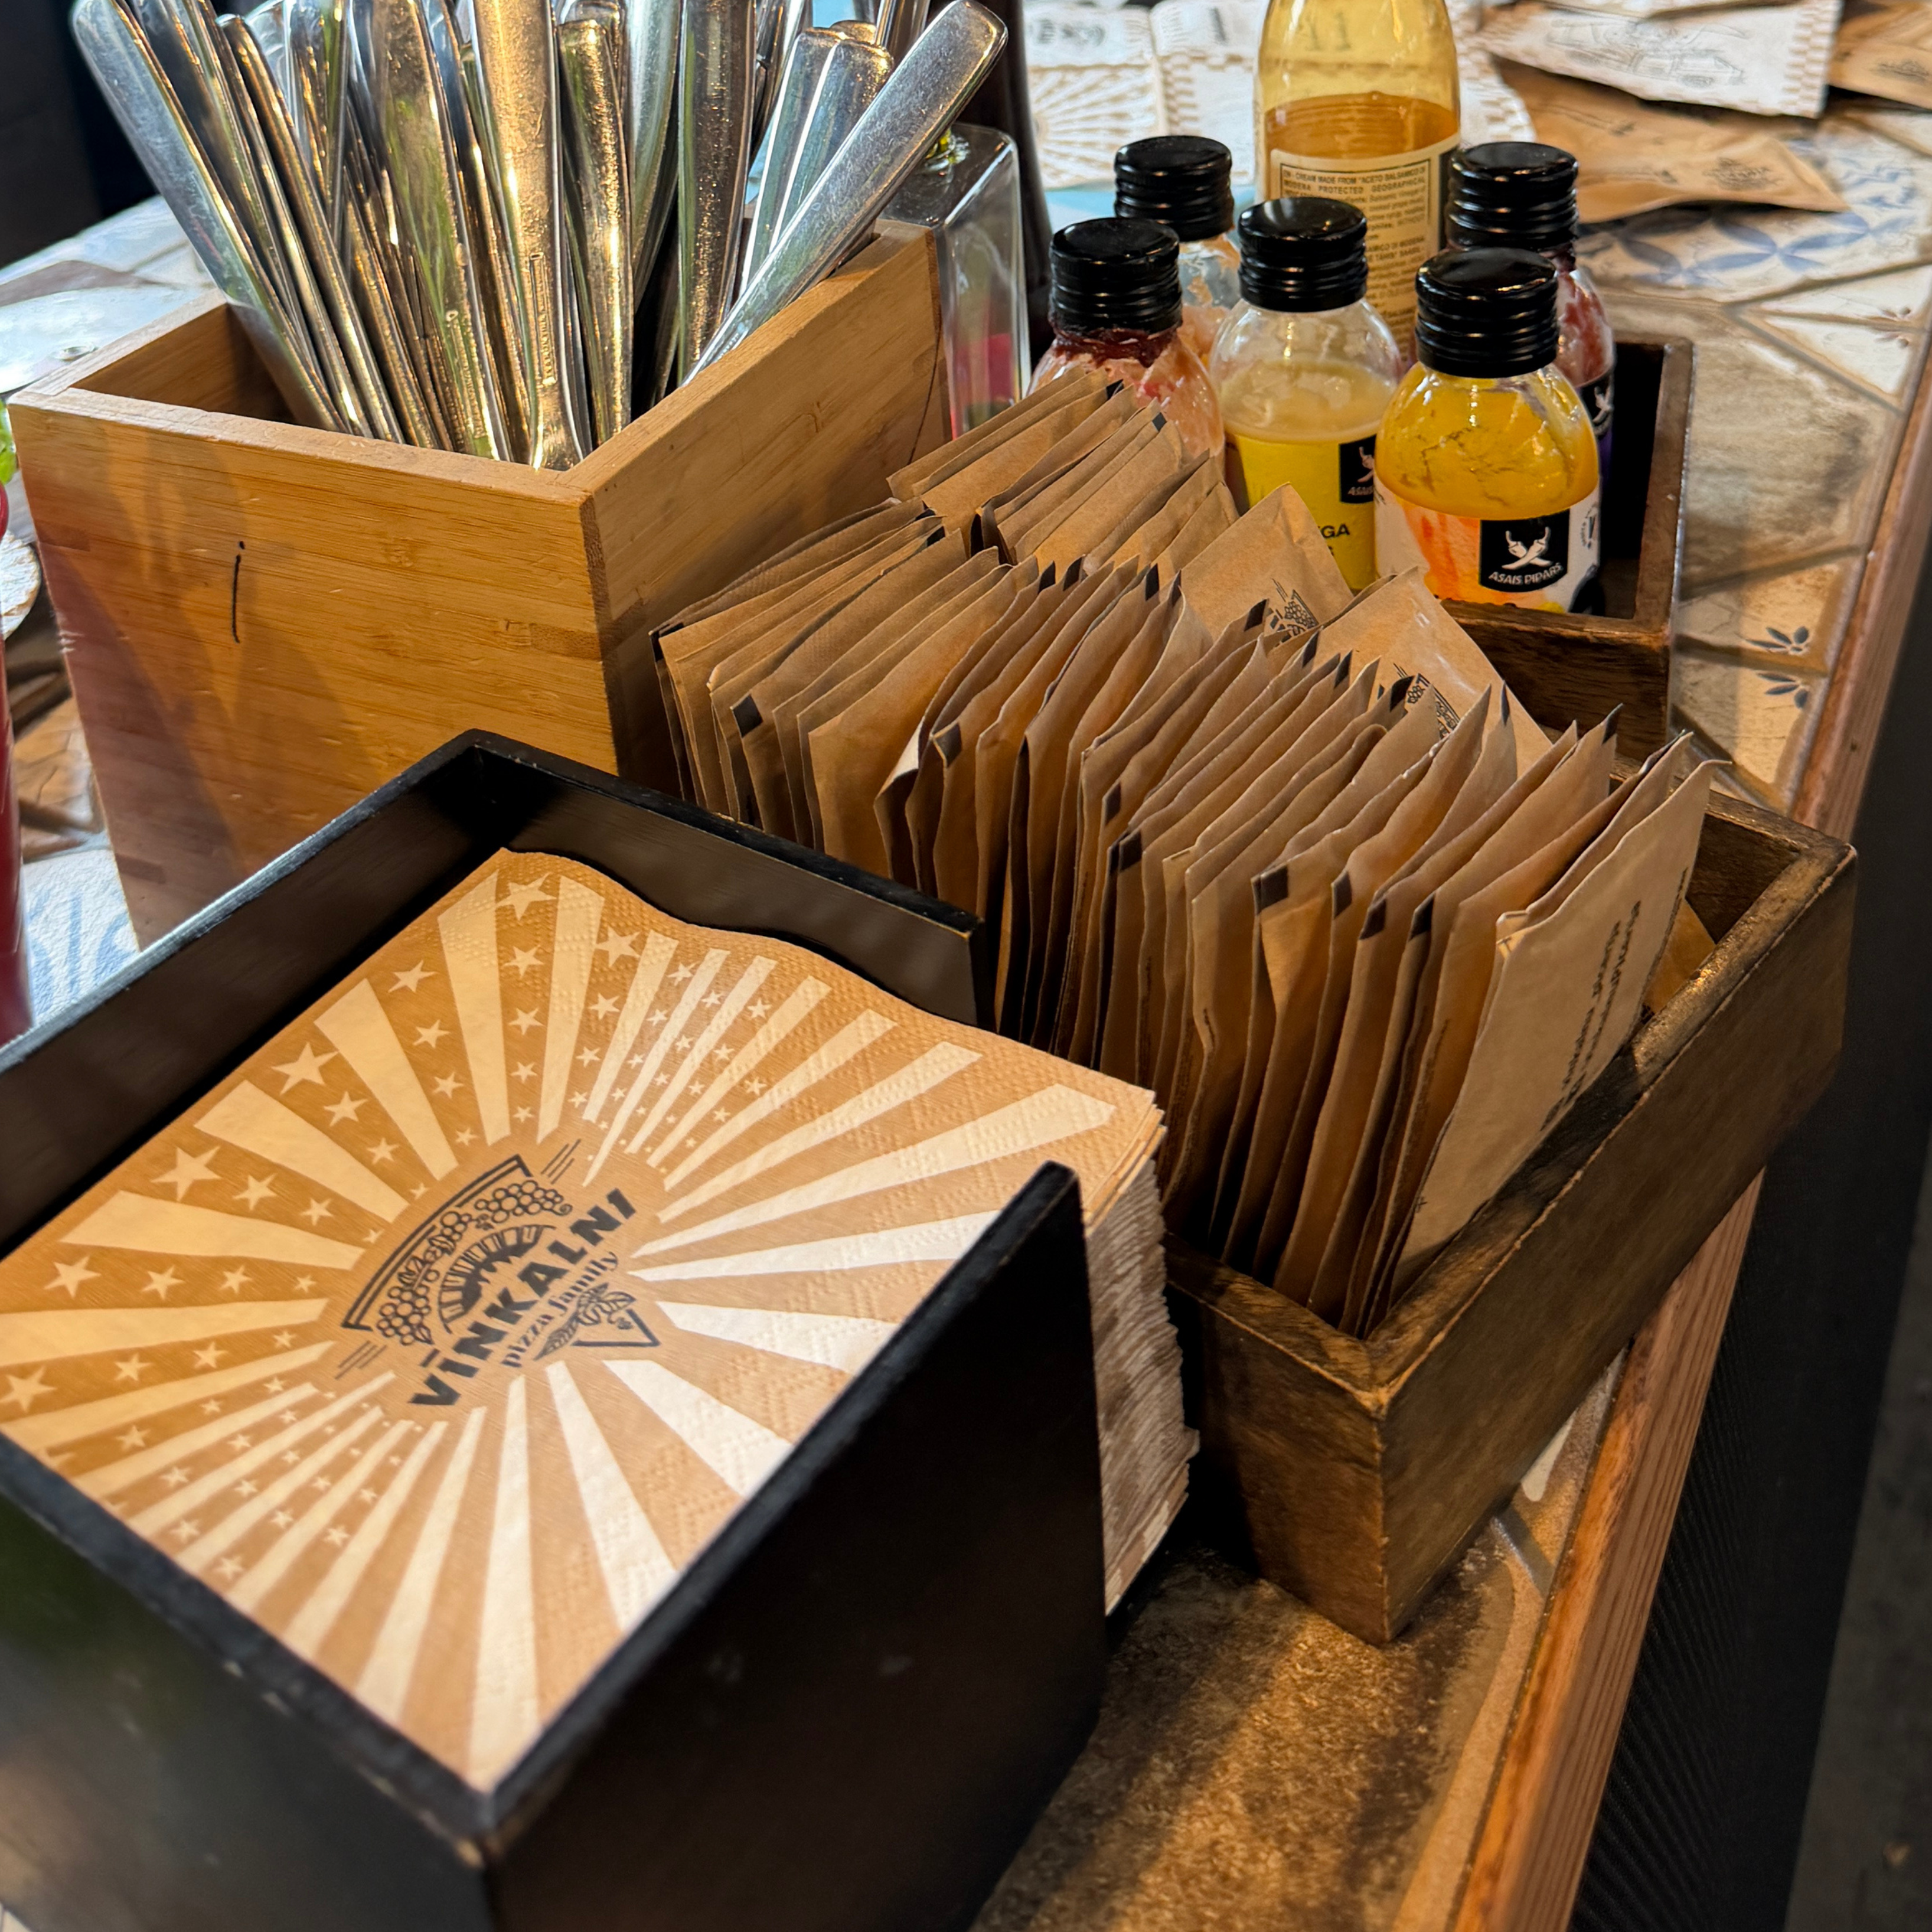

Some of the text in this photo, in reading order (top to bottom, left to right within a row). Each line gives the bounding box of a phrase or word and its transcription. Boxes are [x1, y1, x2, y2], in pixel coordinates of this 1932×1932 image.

[1317, 175, 1336, 184] MADE
[1318, 185, 1363, 194] PROTECTED
[1371, 177, 1425, 192] GEOGRAPHICAL
[1319, 523, 1350, 539] GA
[1488, 562, 1564, 586] ASAIS PIPARS
[407, 1187, 637, 1406] VĪNKALNI
[500, 1251, 618, 1368] pizza family
